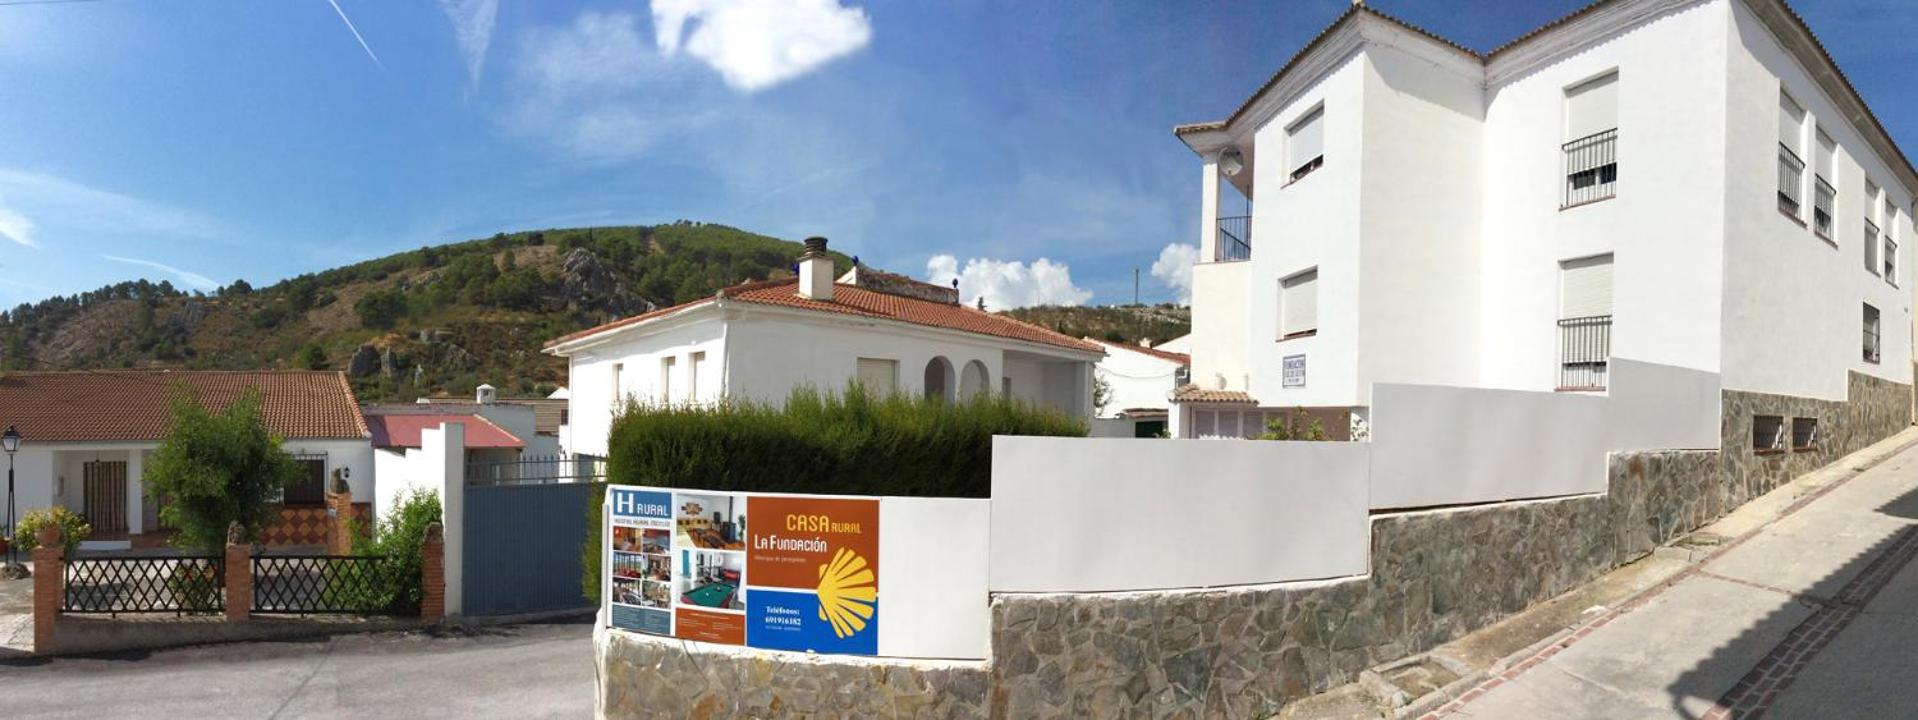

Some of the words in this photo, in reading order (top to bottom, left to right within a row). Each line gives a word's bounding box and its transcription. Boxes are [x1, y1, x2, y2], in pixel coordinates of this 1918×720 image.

[617, 492, 634, 514] H
[637, 503, 670, 517] RURAL
[786, 513, 830, 533] CASA
[831, 522, 862, 534] RURAL
[765, 616, 802, 626] 691916182
